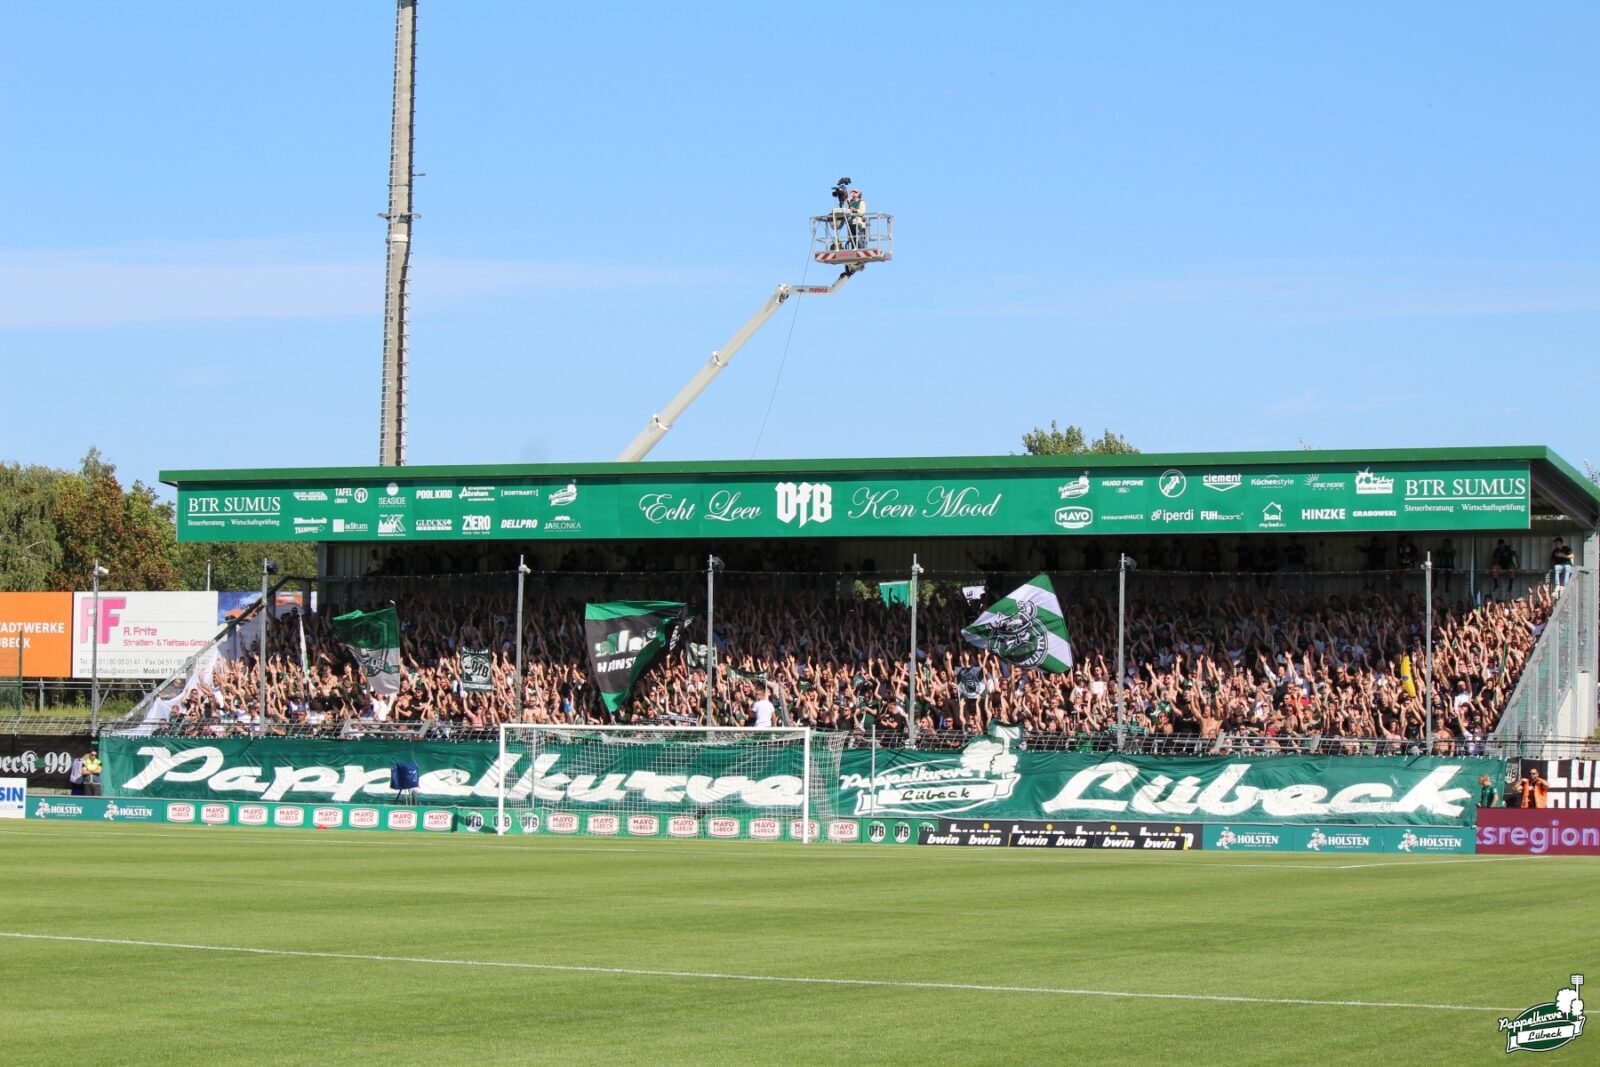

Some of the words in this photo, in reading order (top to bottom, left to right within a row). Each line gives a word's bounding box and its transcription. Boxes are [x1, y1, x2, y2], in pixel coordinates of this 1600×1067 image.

[1202, 473, 1242, 482] clement
[1404, 480, 1446, 496] BTR
[1452, 478, 1526, 496] SUMUS
[188, 498, 220, 512] BTR
[224, 496, 280, 512] SUMUS
[378, 496, 406, 504] SEASIDE
[847, 486, 917, 520] Keen
[921, 486, 1003, 518] Mood
[638, 493, 696, 524] Echt
[1302, 508, 1346, 520] HINZKE
[1404, 504, 1454, 512] Steuerberatung
[1462, 504, 1526, 512] Wirtschaftsprüfung
[1058, 512, 1090, 520] MAYO
[1162, 508, 1194, 524] iperdi
[500, 519, 538, 528] DELLPRO
[544, 522, 582, 530] JABLONKA
[0, 622, 64, 634] ADTWERKE
[44, 752, 72, 774] 99
[122, 746, 805, 806] Pappelkurve
[900, 788, 970, 801] Lübeck
[1042, 761, 1472, 816] Lübeck
[52, 806, 83, 814] HOLSTEN
[120, 808, 153, 816] HOLSTEN
[927, 834, 960, 844] bwin
[968, 834, 1002, 845] bwin
[1018, 834, 1049, 846] bwin
[1056, 836, 1086, 847] bwin
[1102, 836, 1136, 848] bwin
[1144, 838, 1176, 848] bwin
[1237, 834, 1280, 844] HOLSTEN
[1328, 836, 1370, 846] HOLSTEN
[1419, 837, 1462, 848] HOLSTEN
